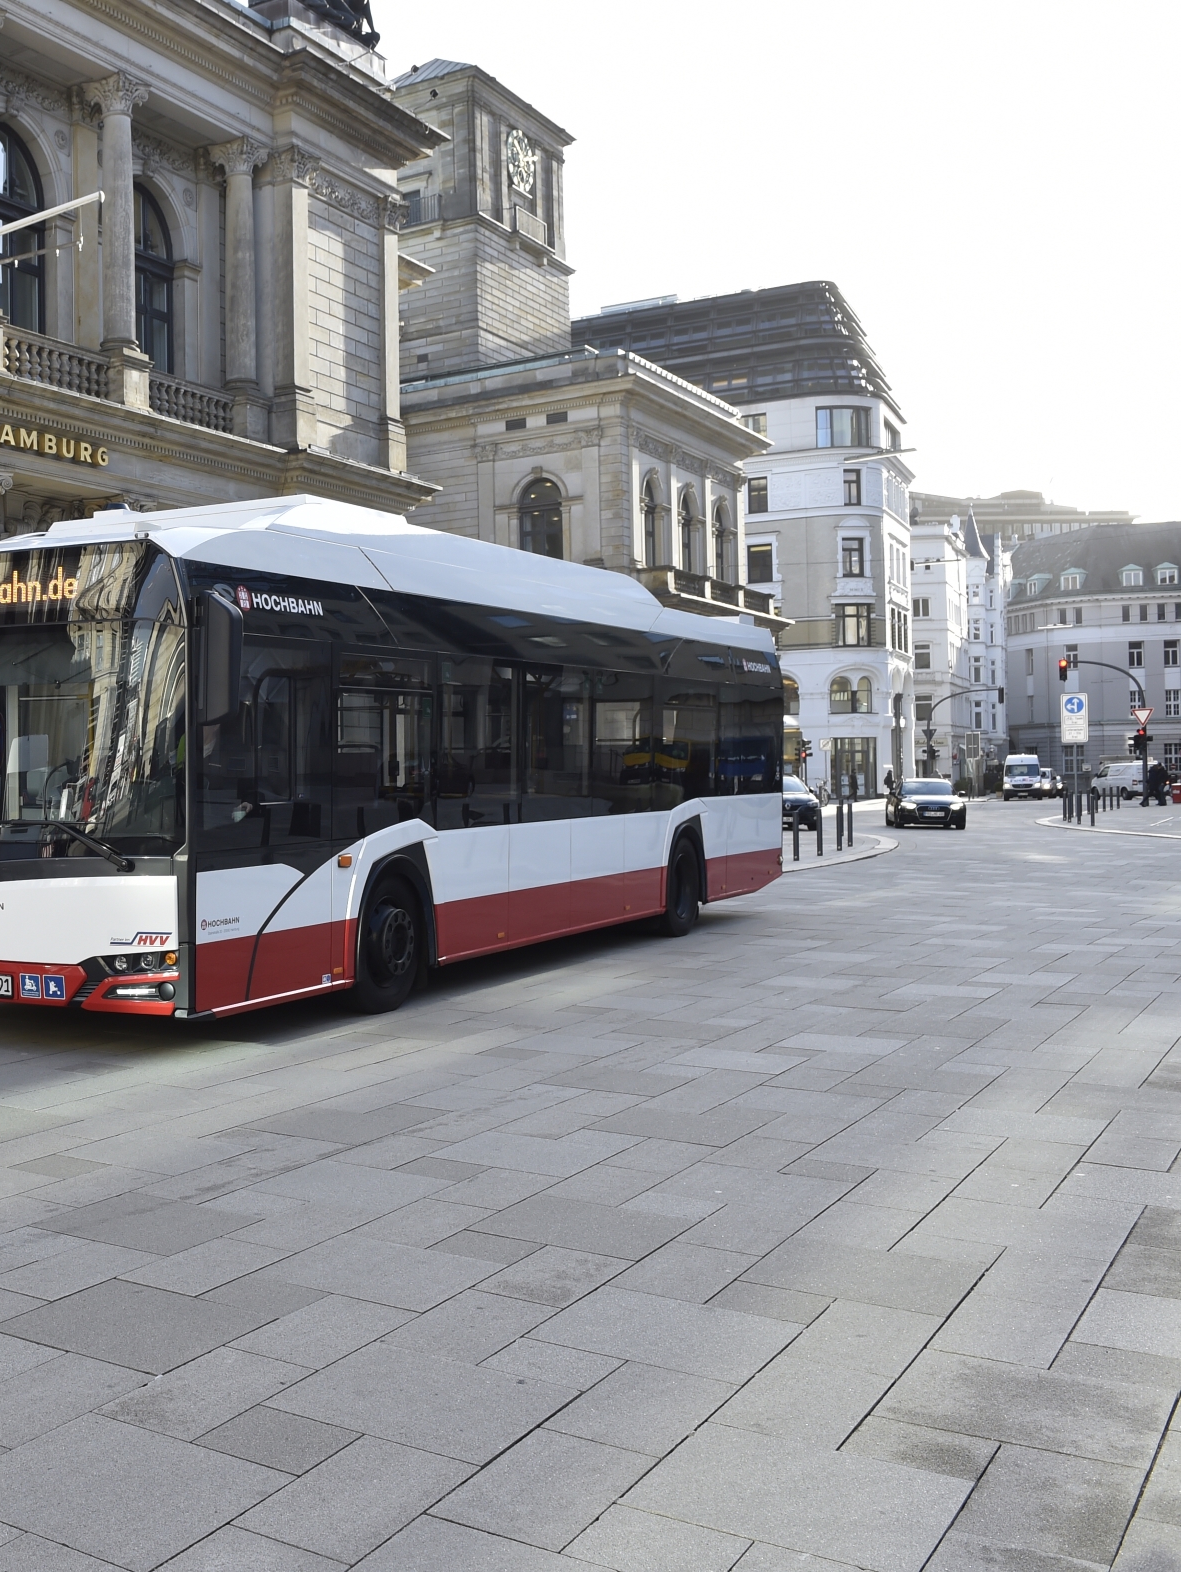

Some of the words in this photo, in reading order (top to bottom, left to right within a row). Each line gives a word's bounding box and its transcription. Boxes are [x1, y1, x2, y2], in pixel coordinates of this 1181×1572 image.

[251, 592, 324, 616] HOCHBAHN
[207, 916, 240, 928] HOCHBAHN
[137, 934, 171, 946] HVV
